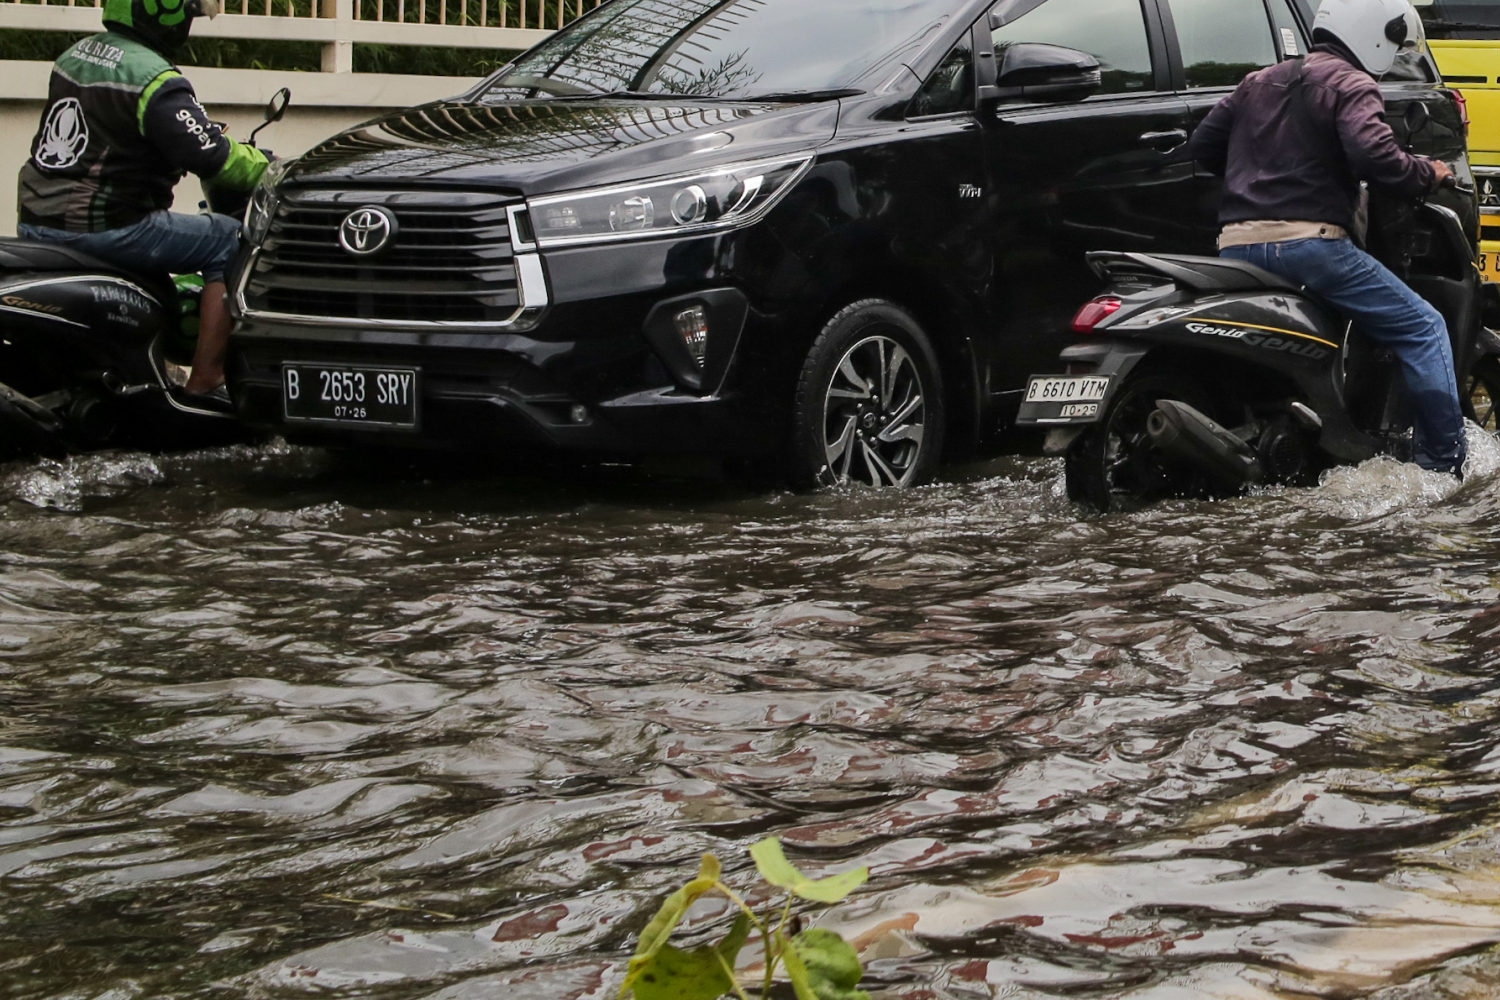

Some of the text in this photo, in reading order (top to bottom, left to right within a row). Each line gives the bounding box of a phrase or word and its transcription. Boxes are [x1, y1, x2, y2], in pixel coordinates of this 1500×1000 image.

[175, 109, 217, 150] gopay
[1, 295, 63, 313] Genio
[1185, 322, 1247, 339] Genio
[287, 369, 410, 405] B 2653 SRY
[1029, 380, 1107, 399] B 6610 VTM
